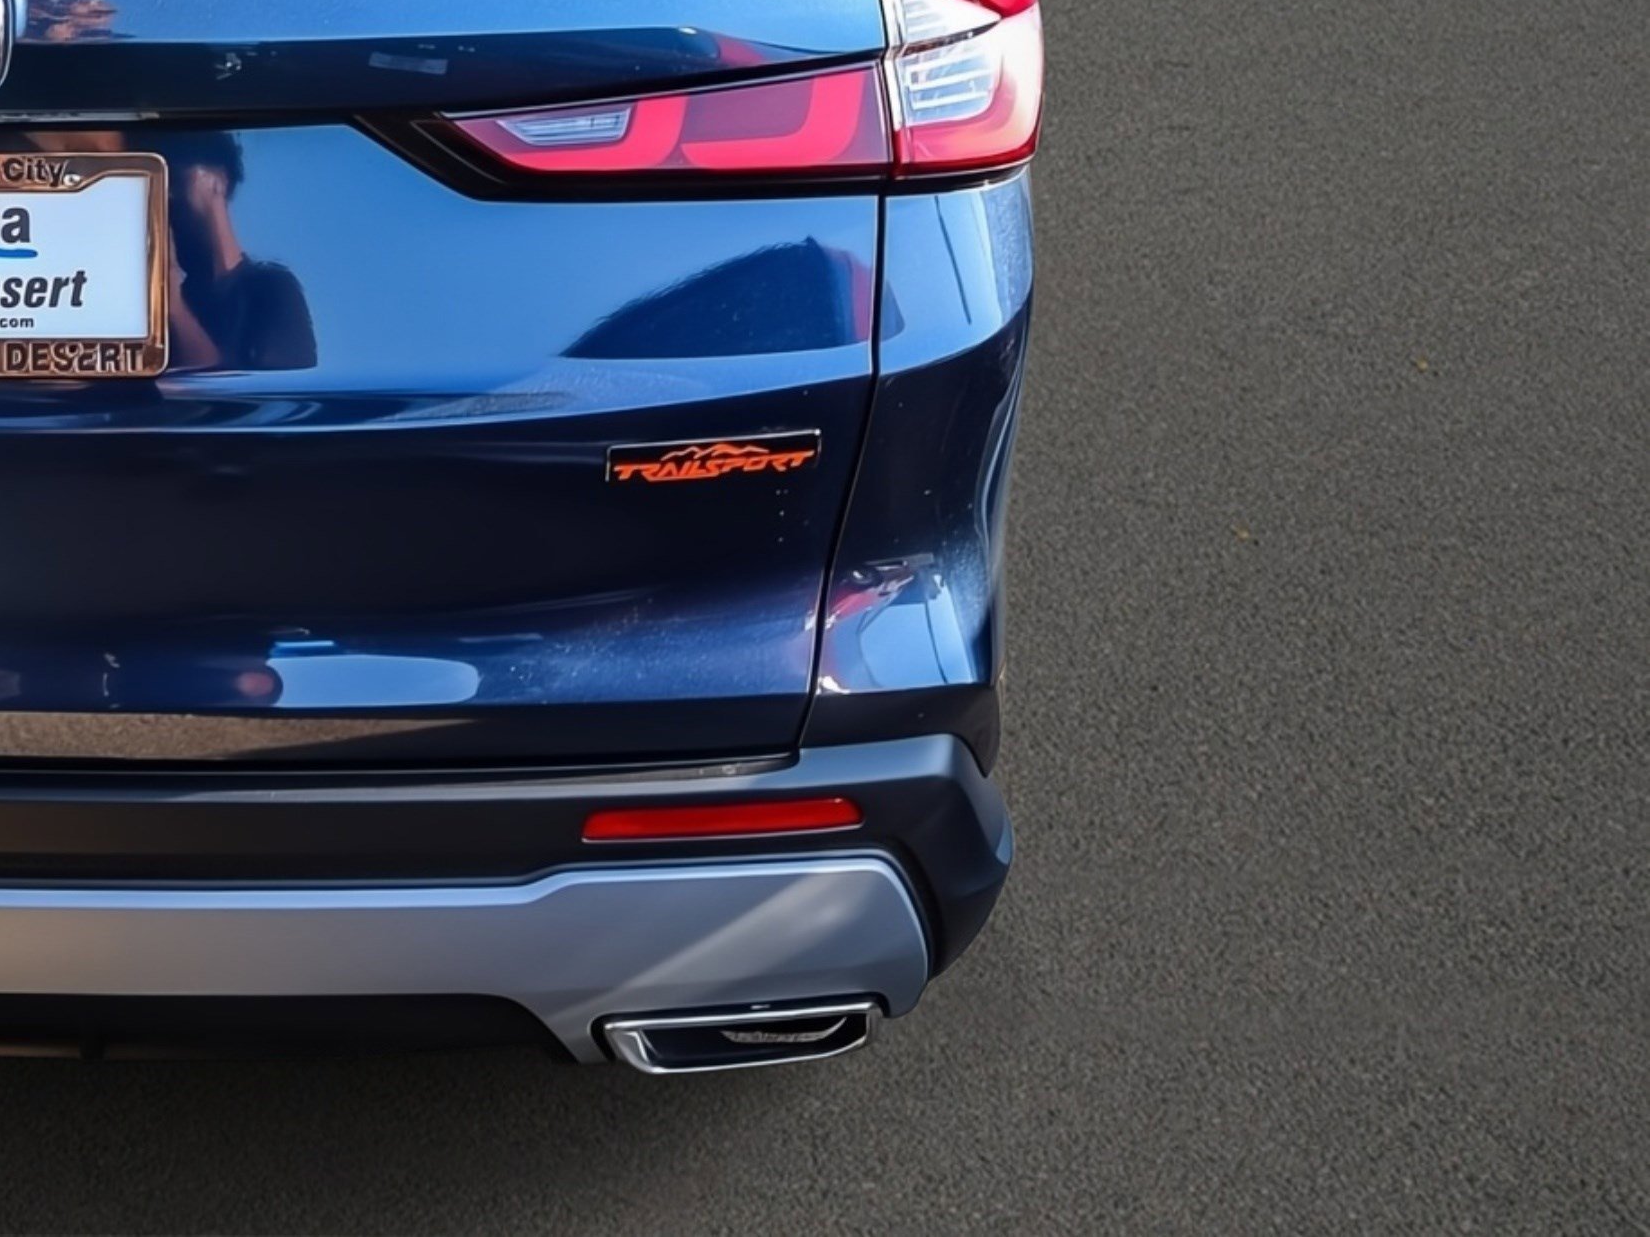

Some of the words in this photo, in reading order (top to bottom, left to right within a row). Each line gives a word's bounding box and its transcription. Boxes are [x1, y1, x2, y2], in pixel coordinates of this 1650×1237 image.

[2, 158, 67, 189] City
[3, 341, 146, 373] DESERT
[613, 449, 816, 482] TRAILSPORT
